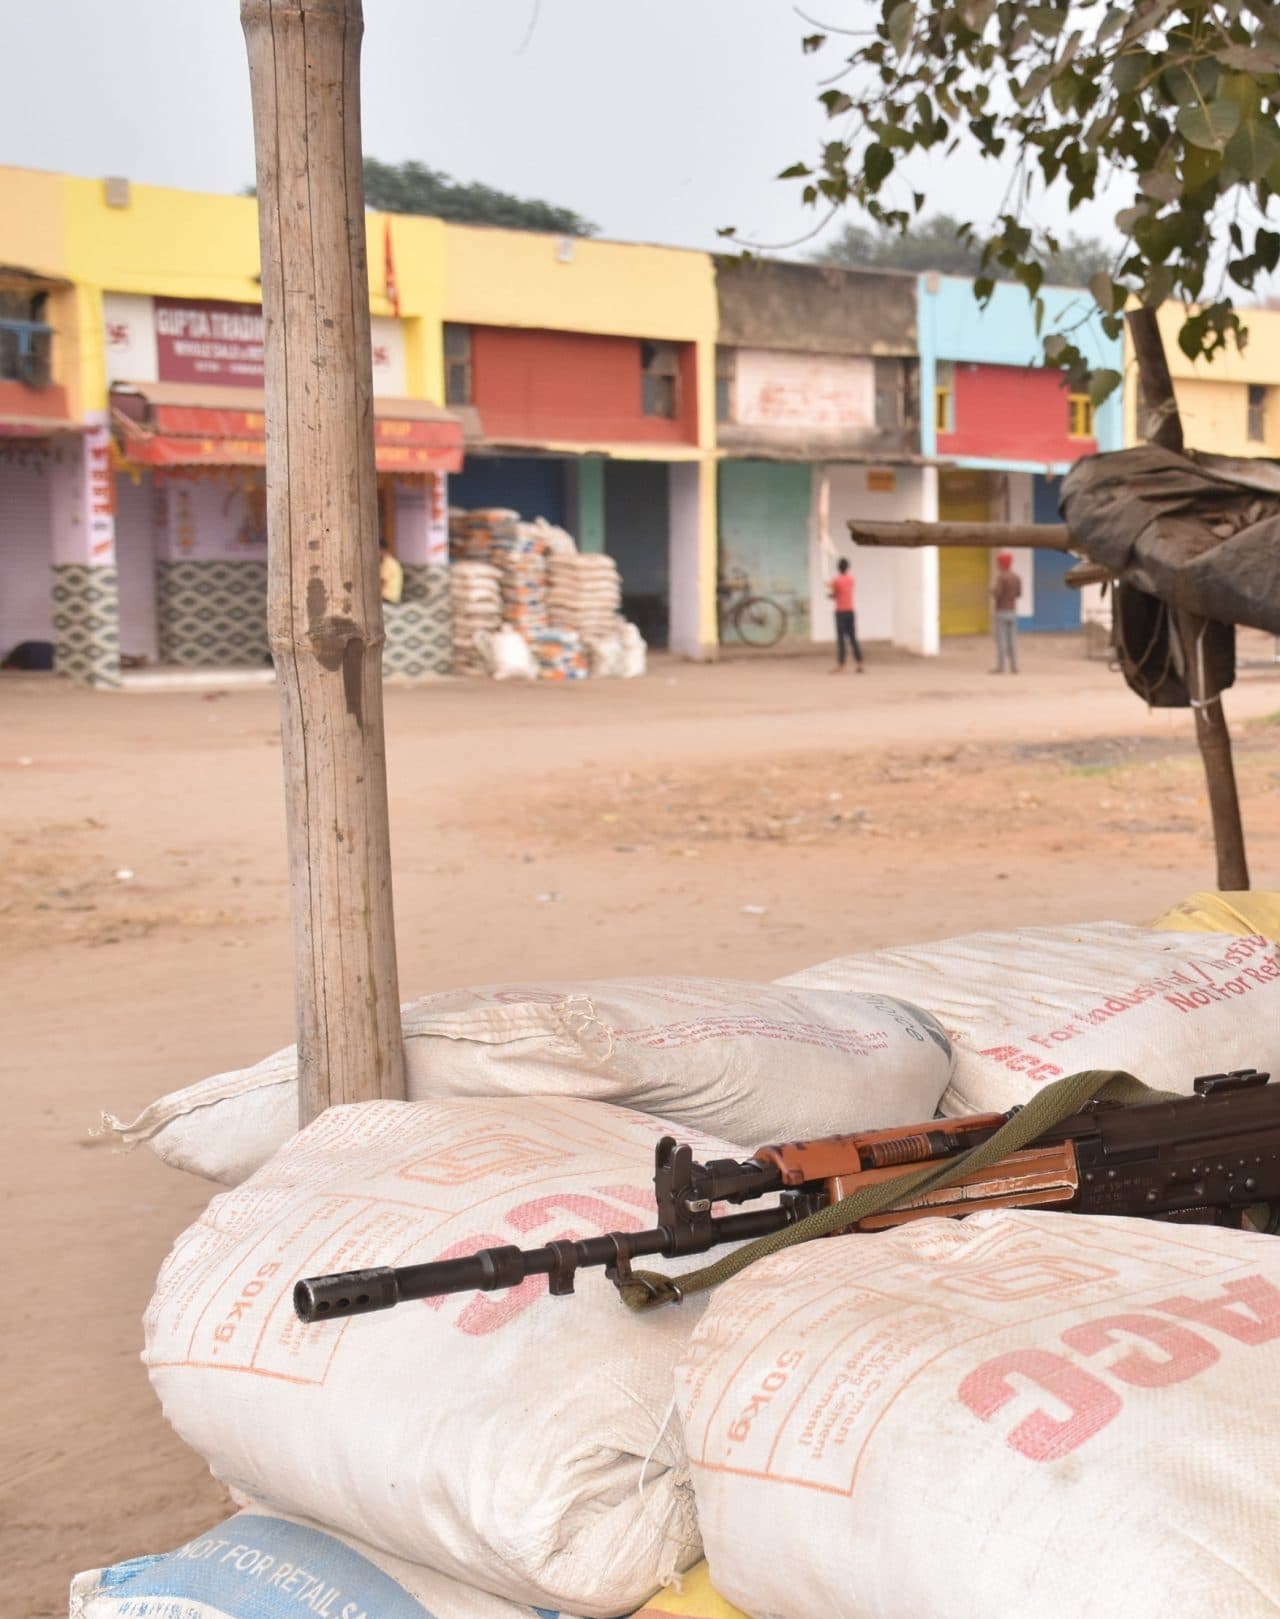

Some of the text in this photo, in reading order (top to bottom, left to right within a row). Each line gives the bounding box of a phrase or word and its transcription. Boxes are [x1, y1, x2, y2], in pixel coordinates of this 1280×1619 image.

[157, 307, 264, 344] GUPTA TRADIN
[1027, 1022, 1084, 1050] For
[977, 1043, 1065, 1083] ACC
[174, 1540, 368, 1619] NOT FOR RETAIL SA
